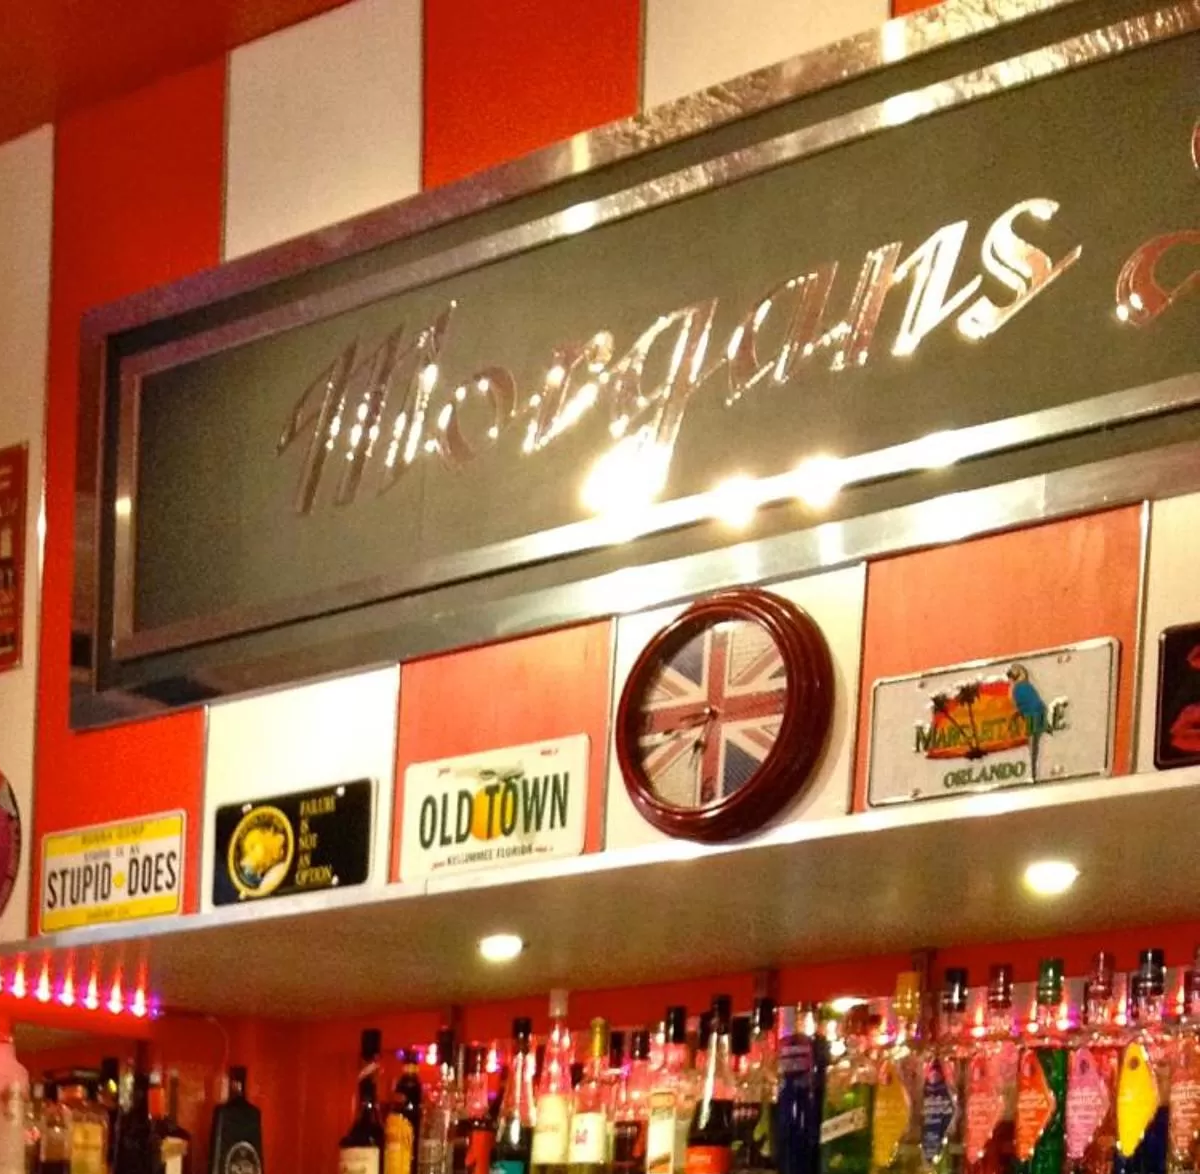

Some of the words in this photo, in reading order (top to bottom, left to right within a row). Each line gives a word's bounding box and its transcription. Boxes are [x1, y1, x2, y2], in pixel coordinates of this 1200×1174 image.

[943, 760, 1027, 788] ORLANDO
[419, 788, 474, 850] OLD
[484, 771, 569, 841] TOWN
[47, 861, 113, 909] STUPID
[127, 851, 177, 897] DOES
